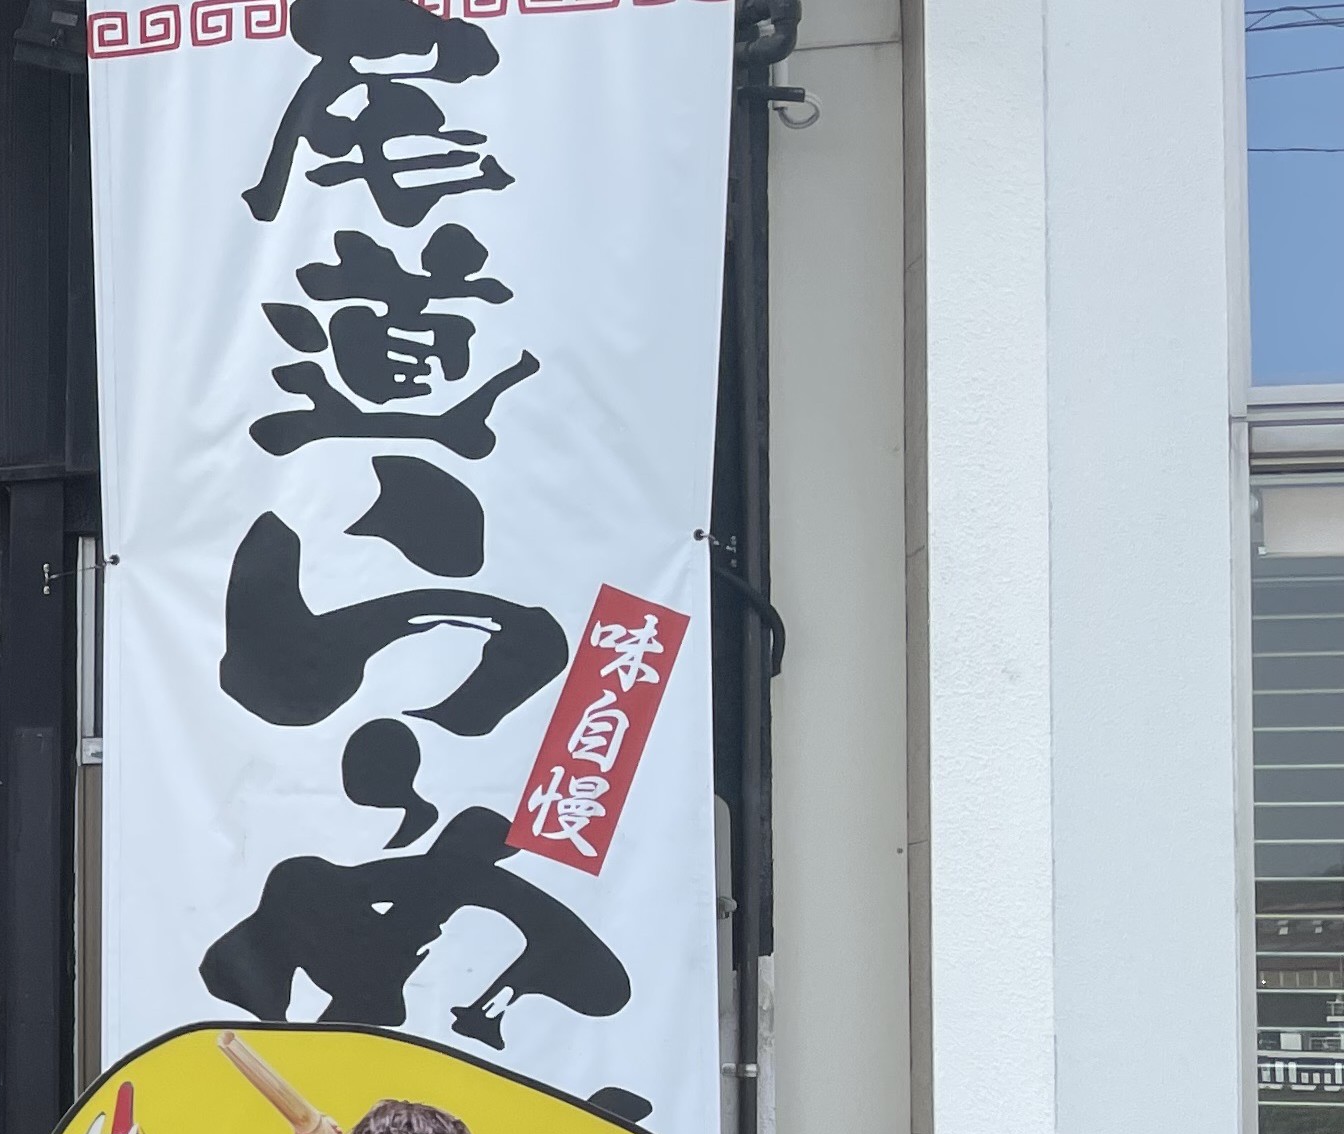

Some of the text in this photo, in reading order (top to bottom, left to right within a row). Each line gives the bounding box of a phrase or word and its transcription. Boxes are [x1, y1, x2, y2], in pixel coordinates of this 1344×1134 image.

[199, 0, 653, 1123] 尾道らーめ
[527, 614, 665, 858] 味自慢
